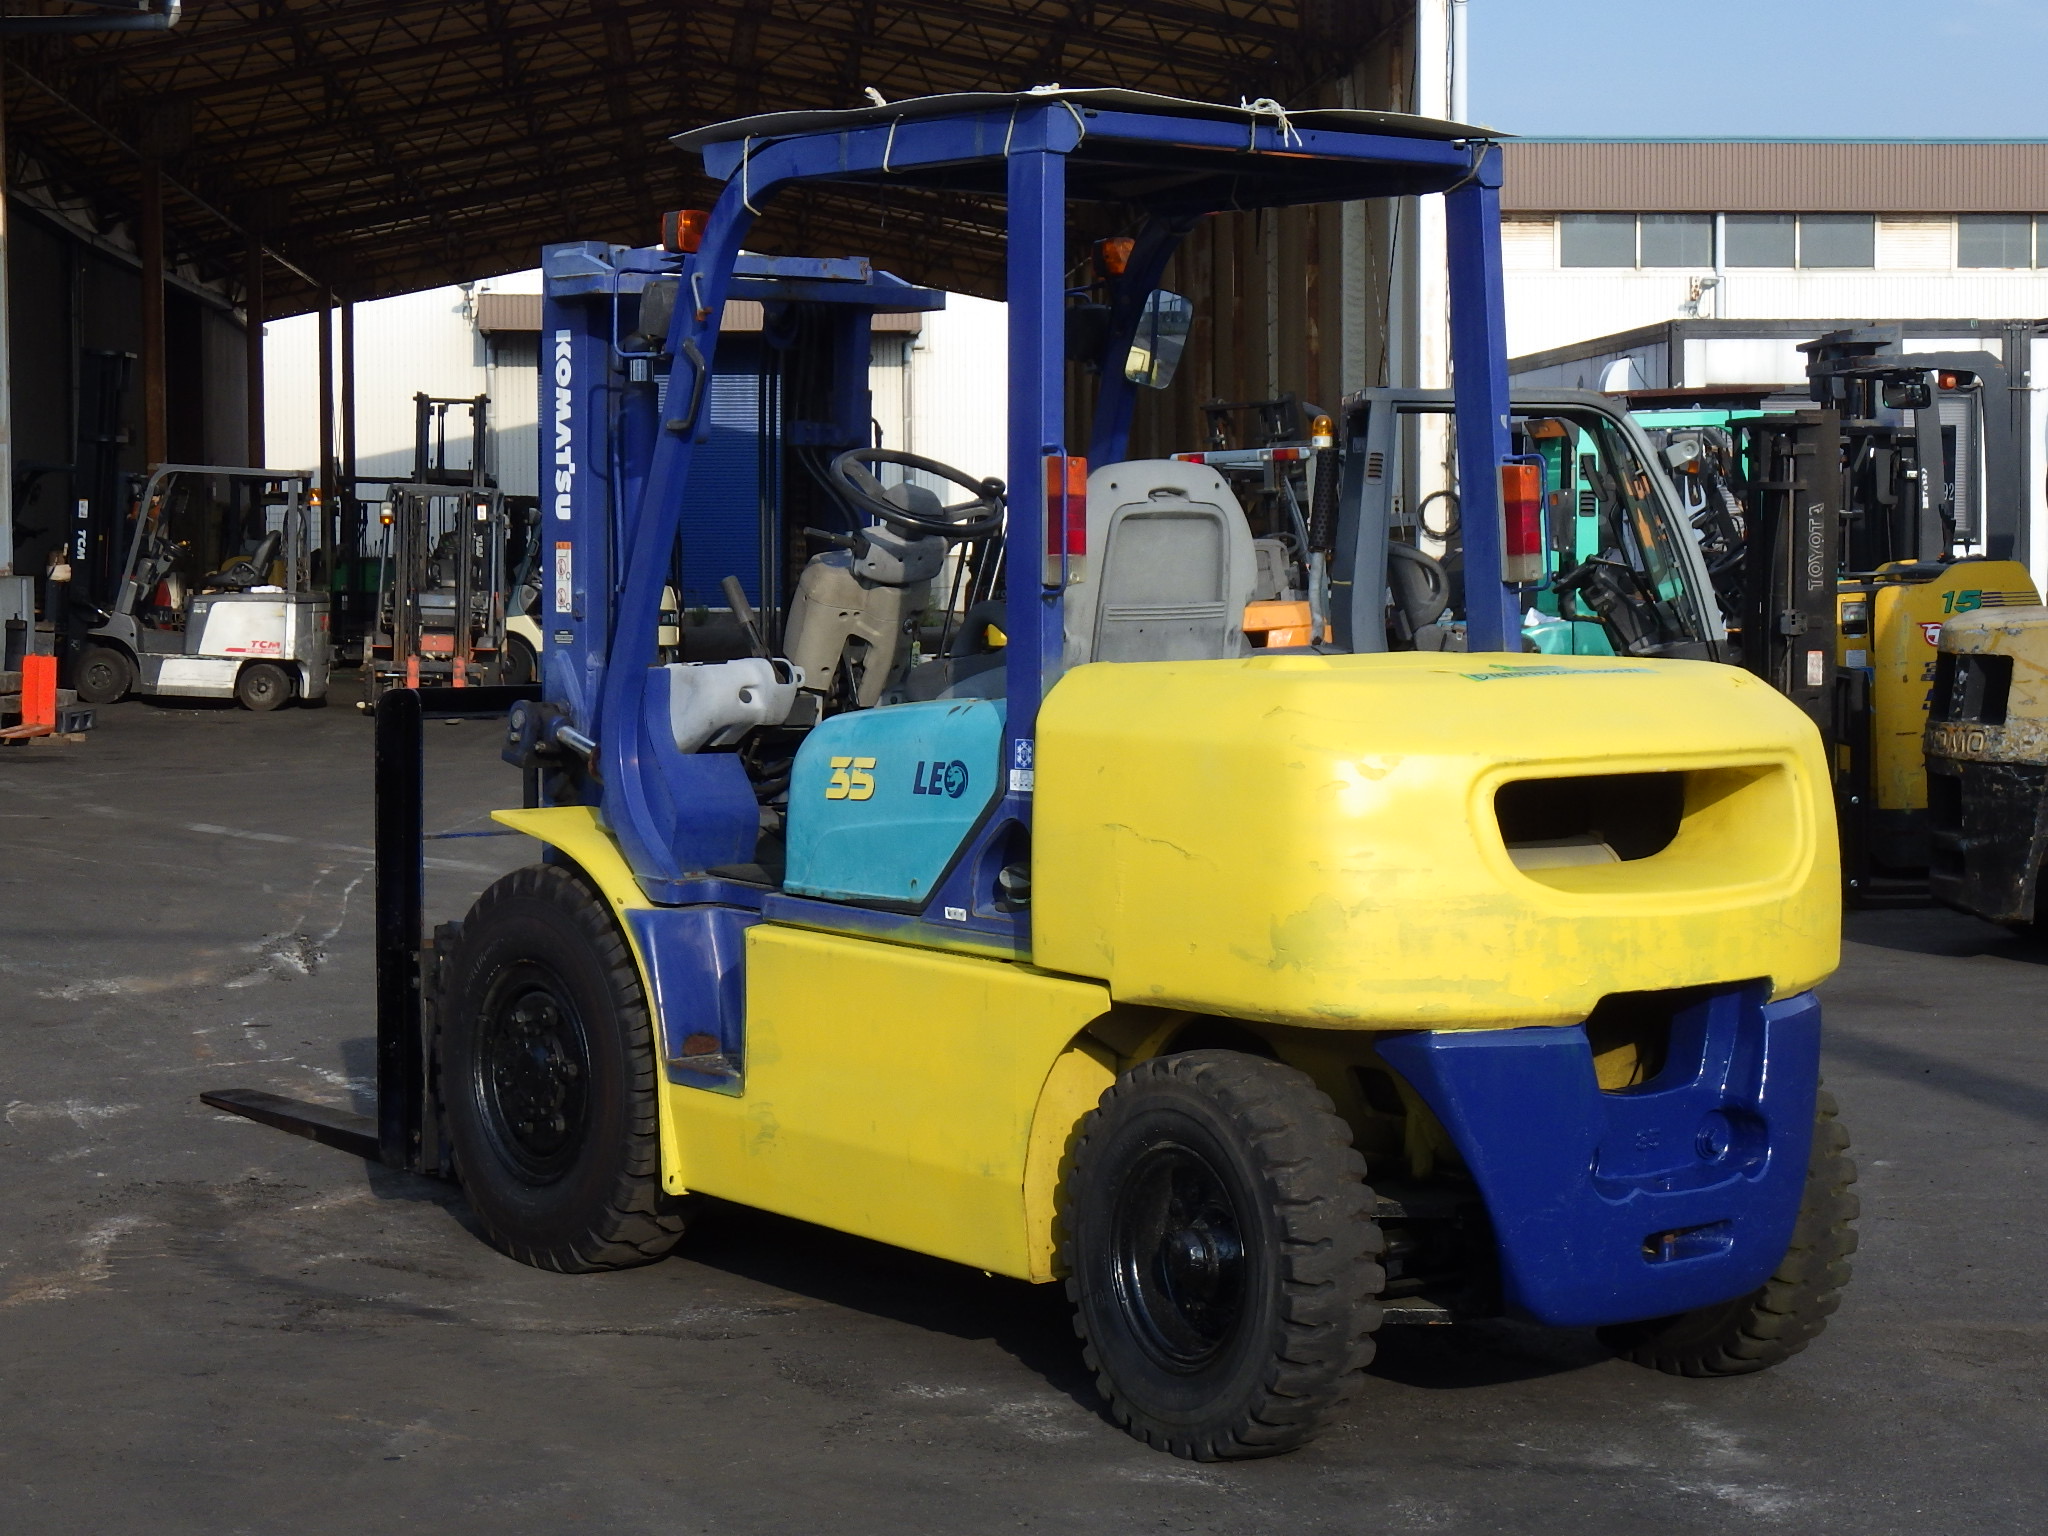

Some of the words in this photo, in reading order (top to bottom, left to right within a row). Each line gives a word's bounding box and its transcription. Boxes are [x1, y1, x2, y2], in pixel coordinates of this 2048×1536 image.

[556, 330, 575, 520] KOMATSU
[77, 530, 86, 560] TCM
[1808, 503, 1824, 591] TOYOTA
[1942, 590, 1982, 613] 15
[826, 757, 876, 801] 35
[913, 760, 968, 798] LEO
